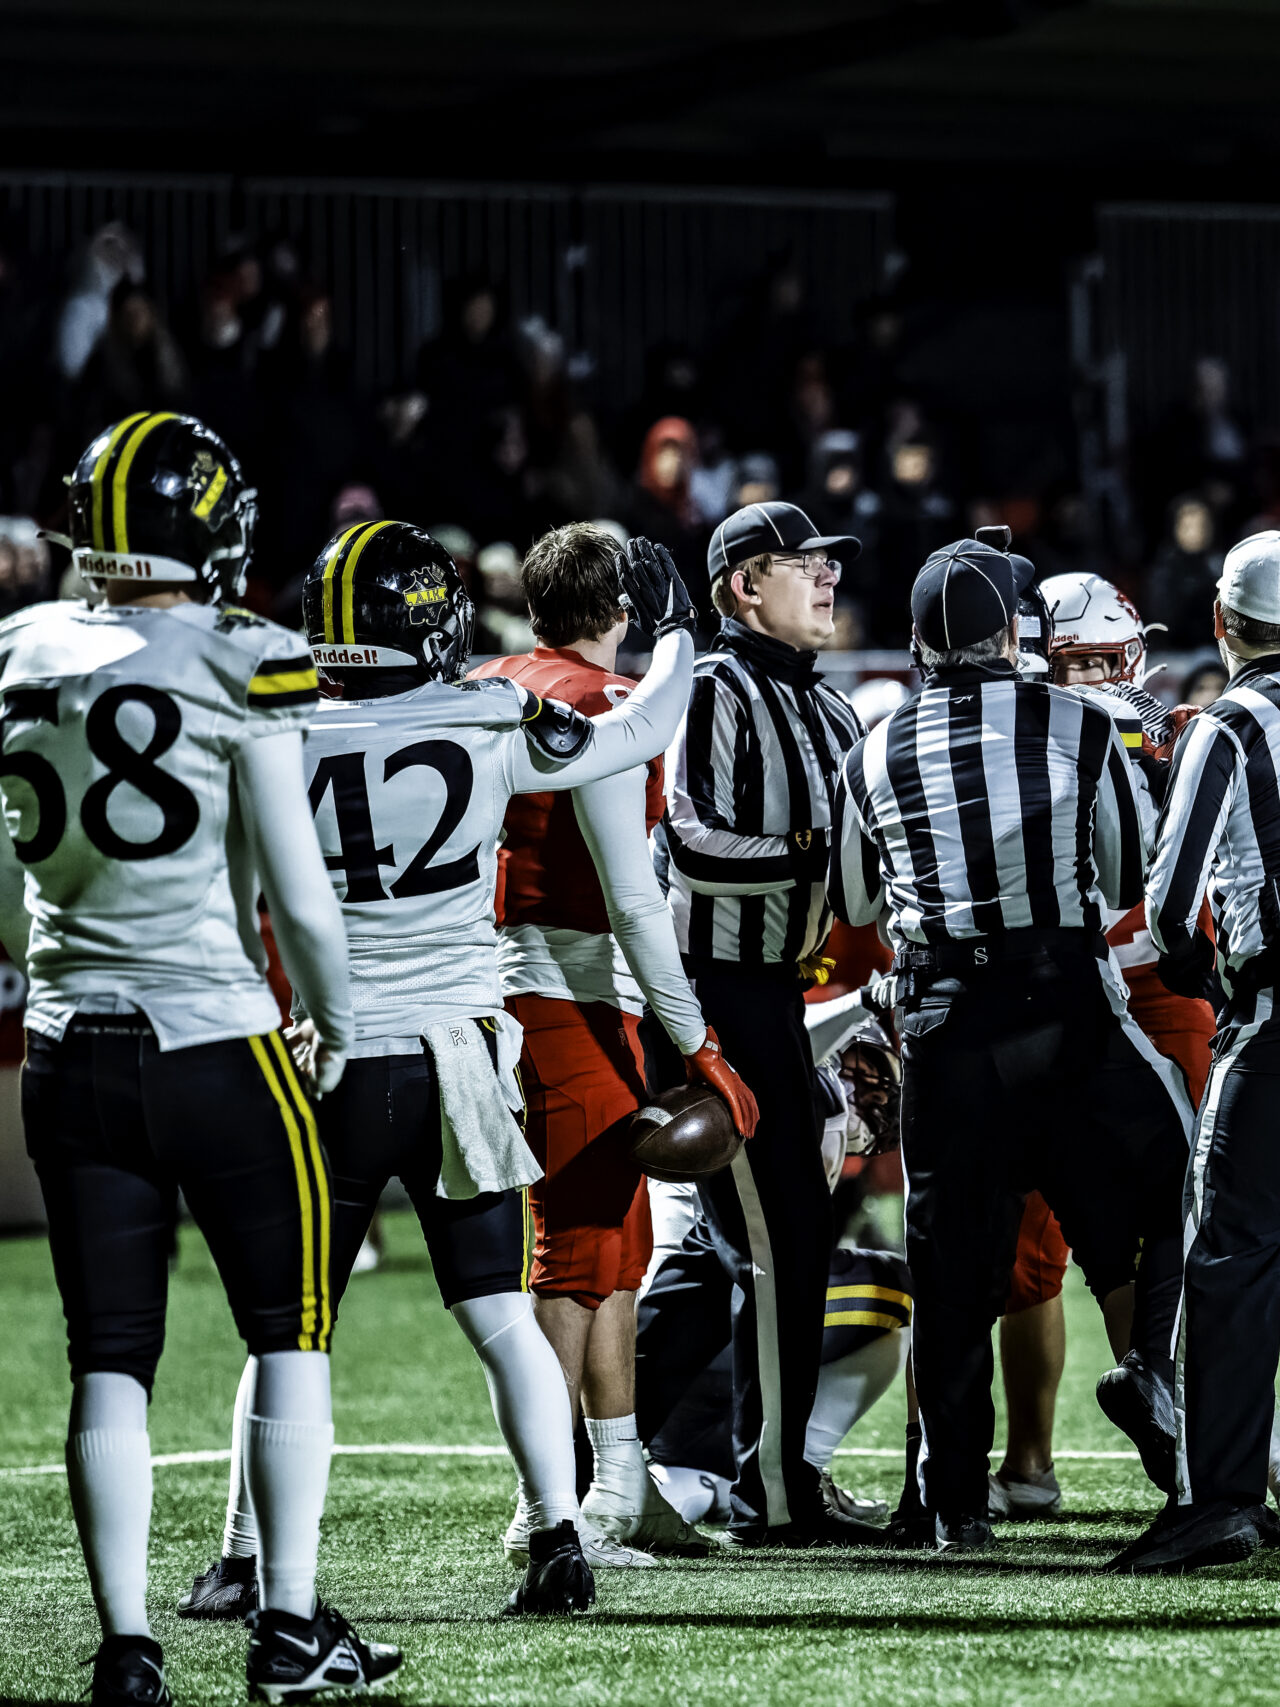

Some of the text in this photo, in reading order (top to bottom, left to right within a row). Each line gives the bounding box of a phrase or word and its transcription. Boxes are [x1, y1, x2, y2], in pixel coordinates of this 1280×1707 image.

[79, 556, 151, 577] Riddell
[313, 649, 378, 664] Riddell
[308, 740, 482, 903] 42
[974, 947, 989, 965] S
